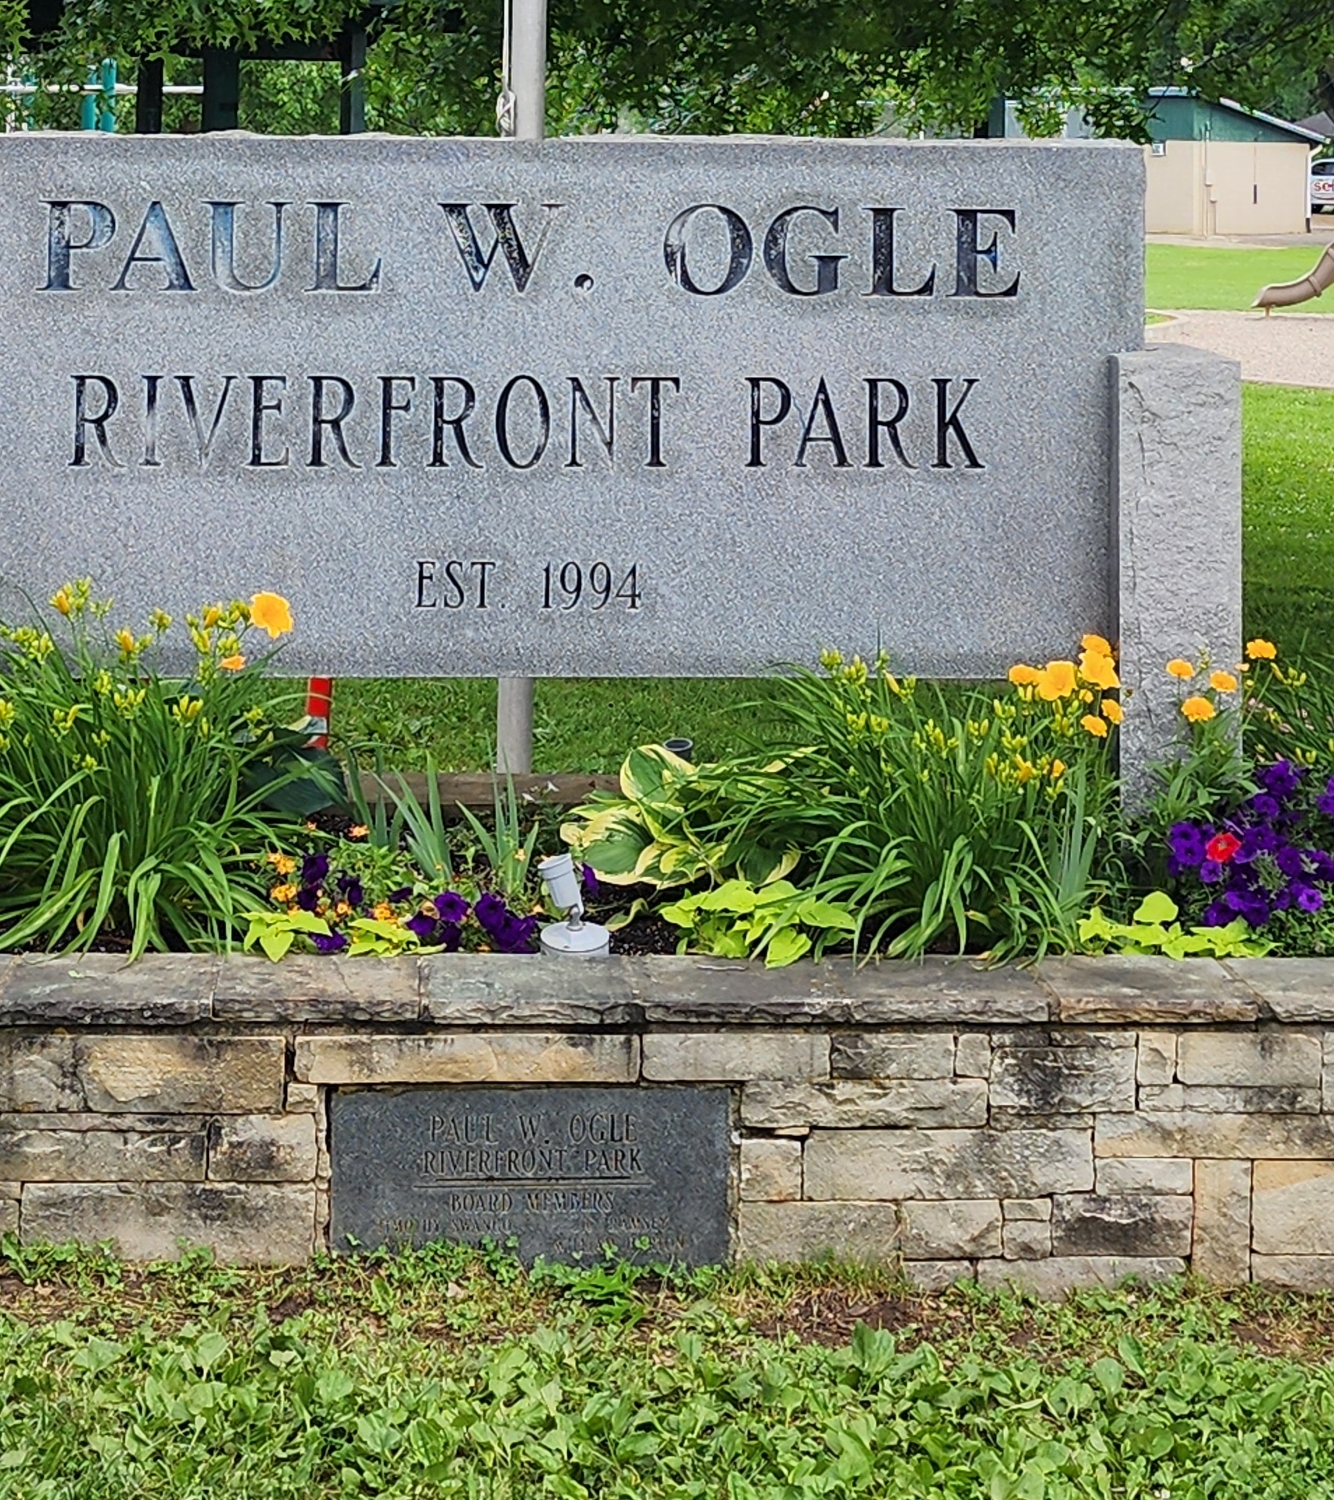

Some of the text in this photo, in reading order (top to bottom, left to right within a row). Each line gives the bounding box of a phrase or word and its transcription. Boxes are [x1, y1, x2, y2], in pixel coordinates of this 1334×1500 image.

[35, 200, 1022, 298] PAUL W. OGLE
[67, 374, 986, 470] RIVERFRONT PARK
[414, 560, 643, 610] EST. 1994
[429, 1113, 639, 1146] PAUL W. OGLE
[423, 1148, 645, 1176] RIVERFRONT PARK
[449, 1191, 615, 1214] BOARD MEMBERS
